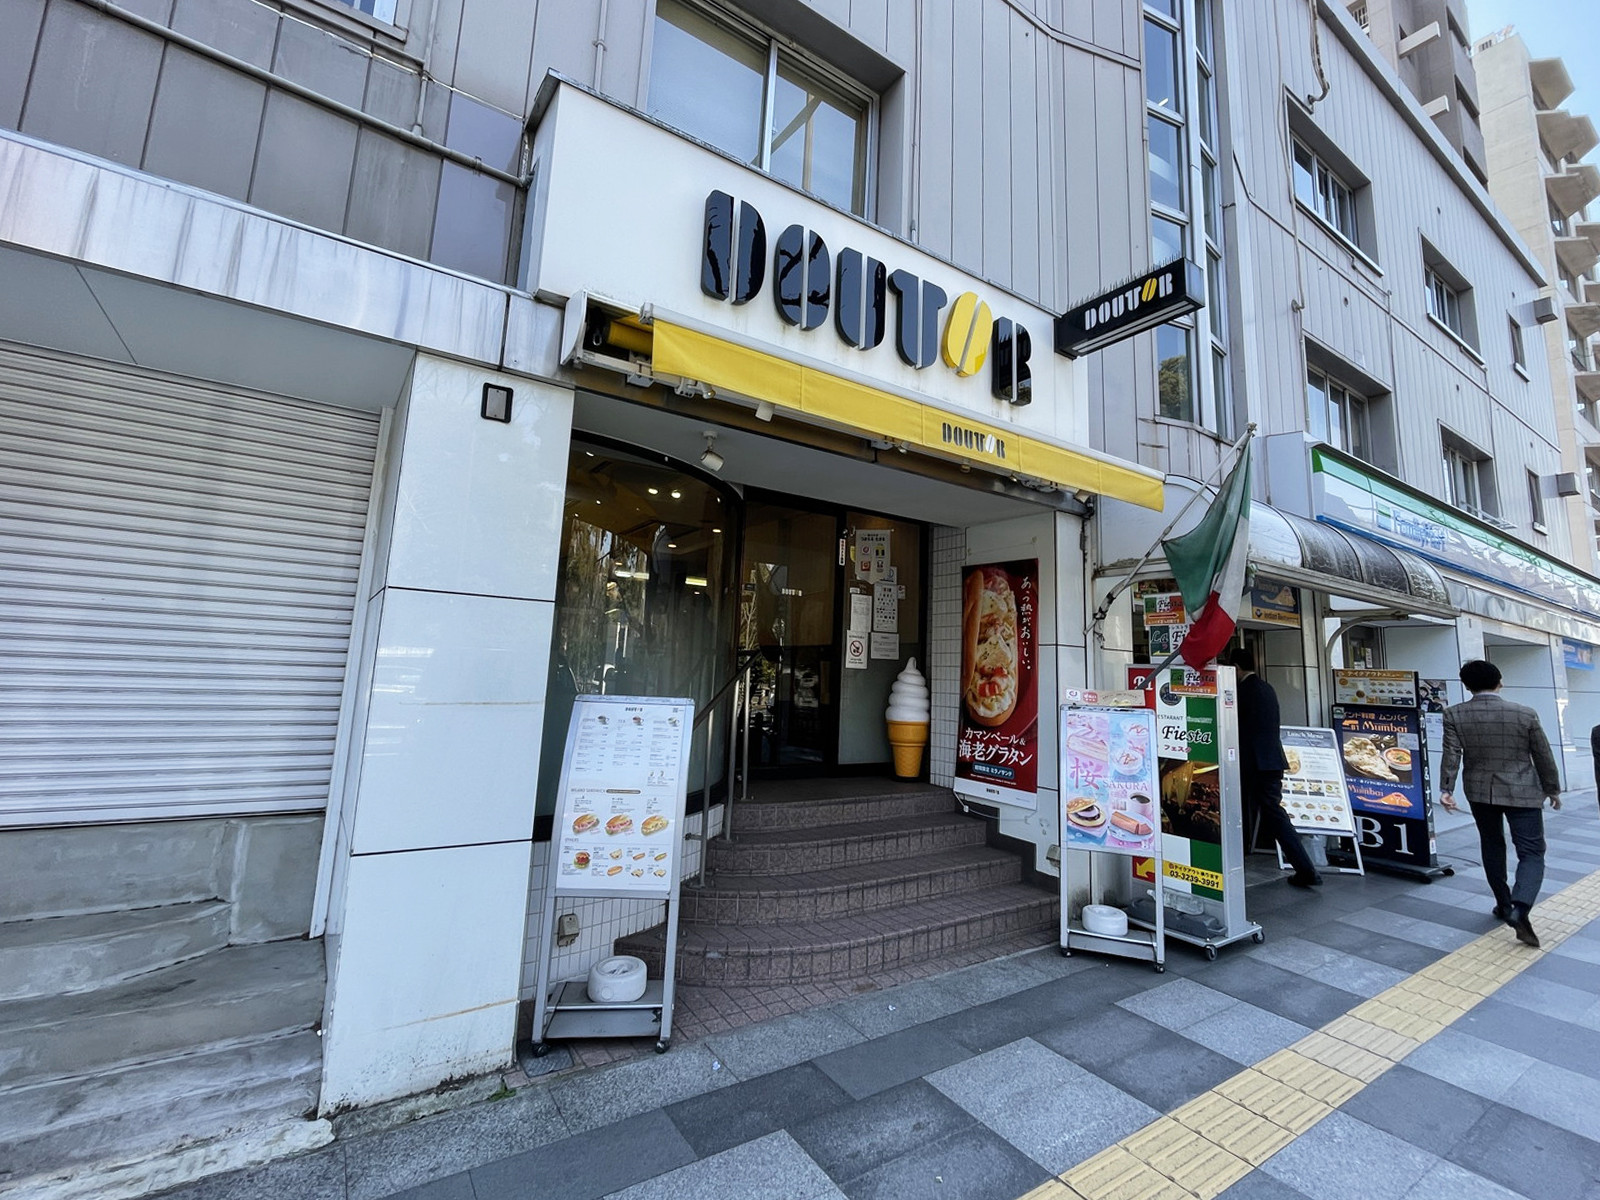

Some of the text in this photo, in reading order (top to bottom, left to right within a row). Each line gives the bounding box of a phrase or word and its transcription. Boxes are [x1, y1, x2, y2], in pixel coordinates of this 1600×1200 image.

[700, 189, 1033, 407] DOUTOR
[1085, 272, 1173, 331] DOUTOR
[942, 422, 1005, 459] DOUTOR
[1151, 630, 1169, 644] La
[1162, 725, 1212, 745] Fiesta
[1362, 720, 1408, 733] Mumbai
[959, 739, 1033, 767] 海老グラタン
[1103, 780, 1149, 792] SAKURA
[1354, 815, 1415, 856] B1
[1169, 870, 1220, 889] 03-3239-3991
